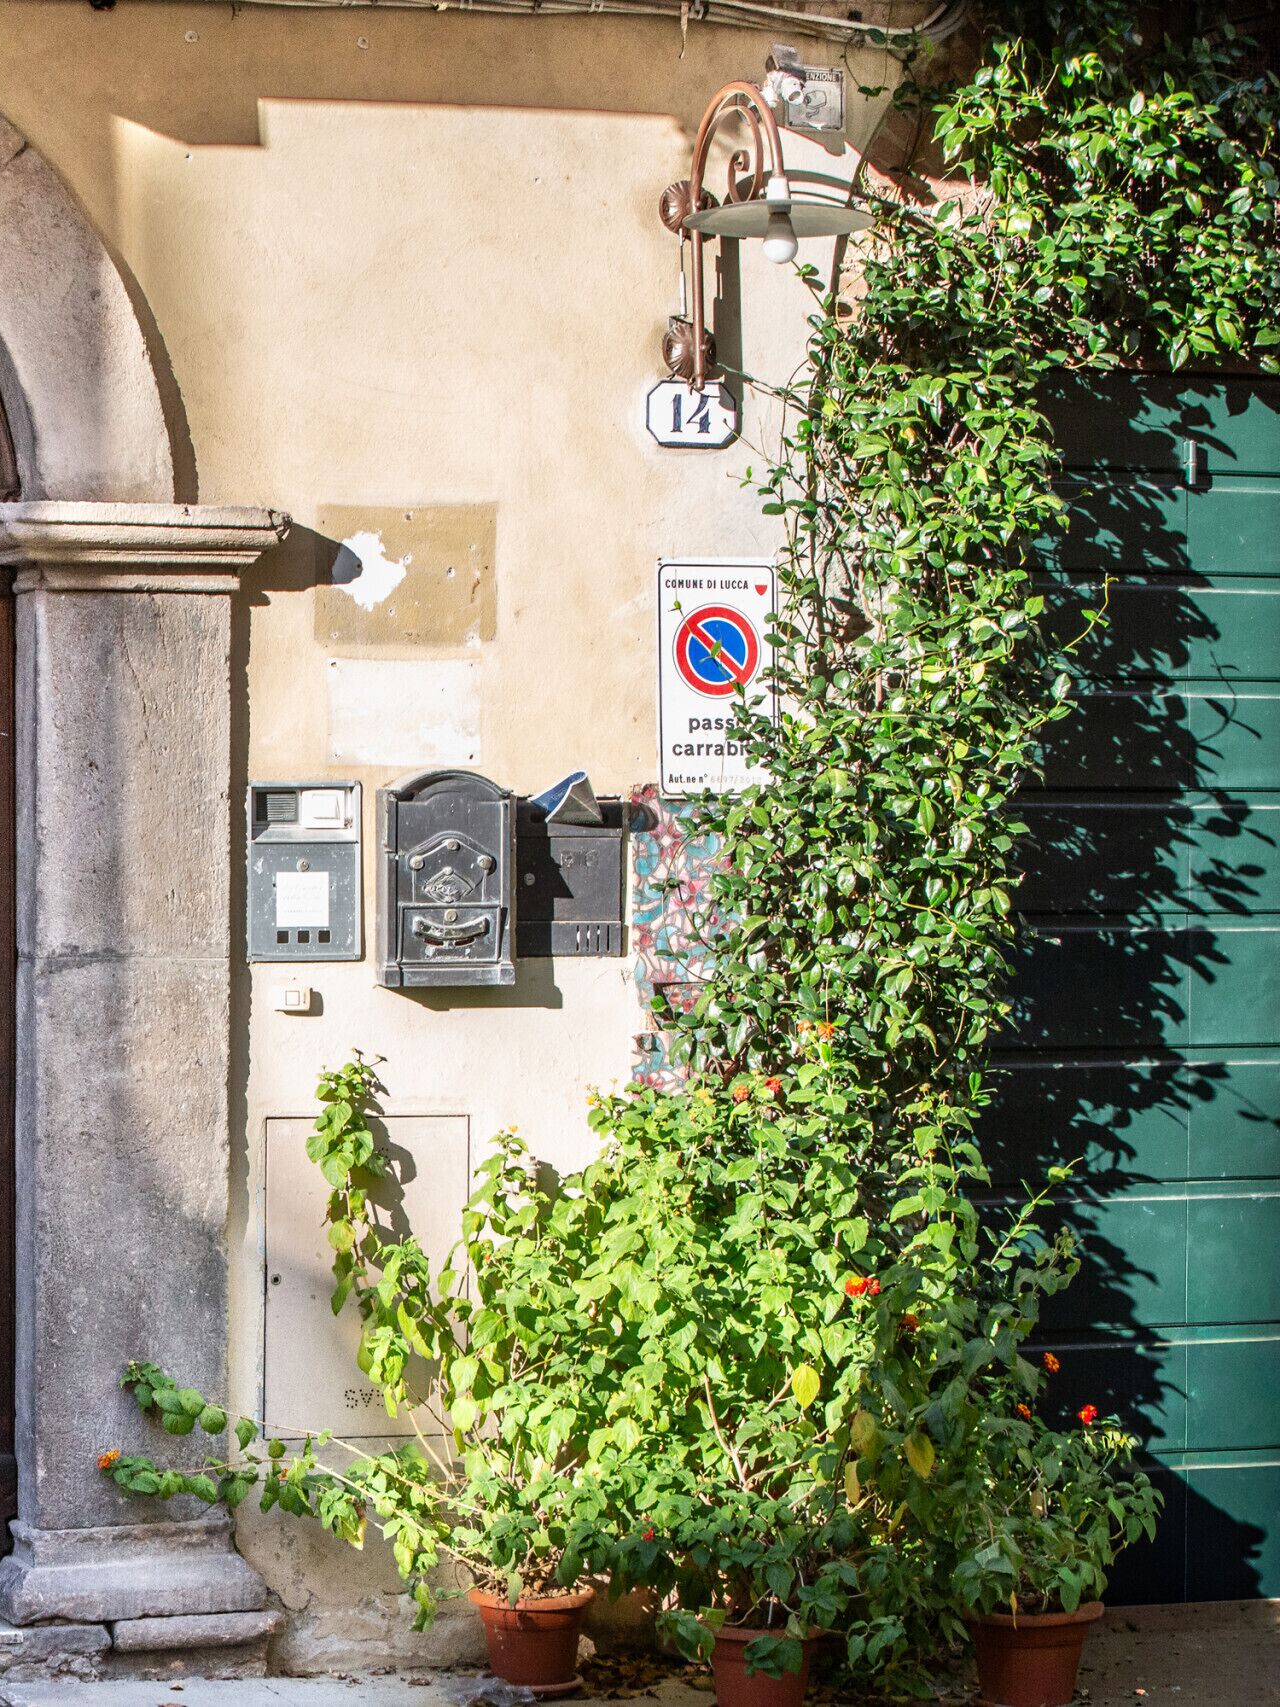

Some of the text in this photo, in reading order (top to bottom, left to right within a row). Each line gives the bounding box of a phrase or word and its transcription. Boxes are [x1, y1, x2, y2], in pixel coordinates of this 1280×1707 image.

[806, 72, 841, 82] ENZIONE
[670, 393, 711, 434] 14
[665, 579, 749, 590] COMUNE DI LUCCA
[688, 717, 739, 734] pass
